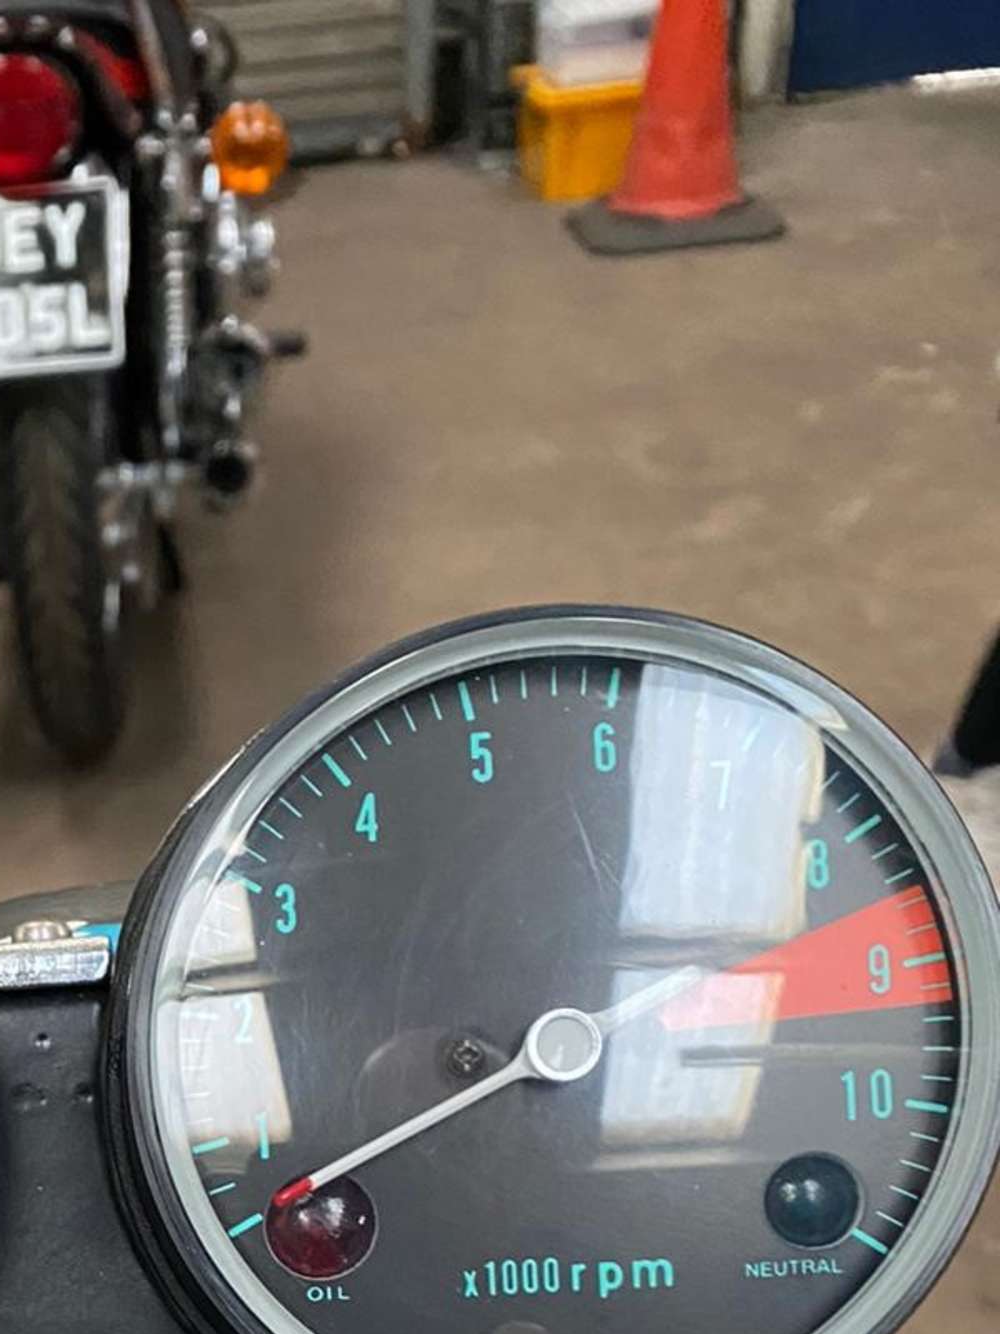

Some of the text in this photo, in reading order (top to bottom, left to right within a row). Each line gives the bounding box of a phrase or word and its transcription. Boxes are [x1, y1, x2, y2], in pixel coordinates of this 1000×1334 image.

[469, 732, 493, 783] 5
[592, 722, 617, 772] 6
[710, 760, 731, 810] 7
[355, 792, 379, 842] 4
[807, 839, 830, 889] 8
[274, 883, 297, 934] 3
[868, 944, 892, 995] 9
[233, 998, 254, 1045] 2
[841, 1068, 894, 1120] 10
[255, 1111, 270, 1160] 1
[306, 1285, 350, 1302] OIL
[571, 1257, 675, 1298] rpm
[744, 1258, 843, 1279] NEUTRAL
